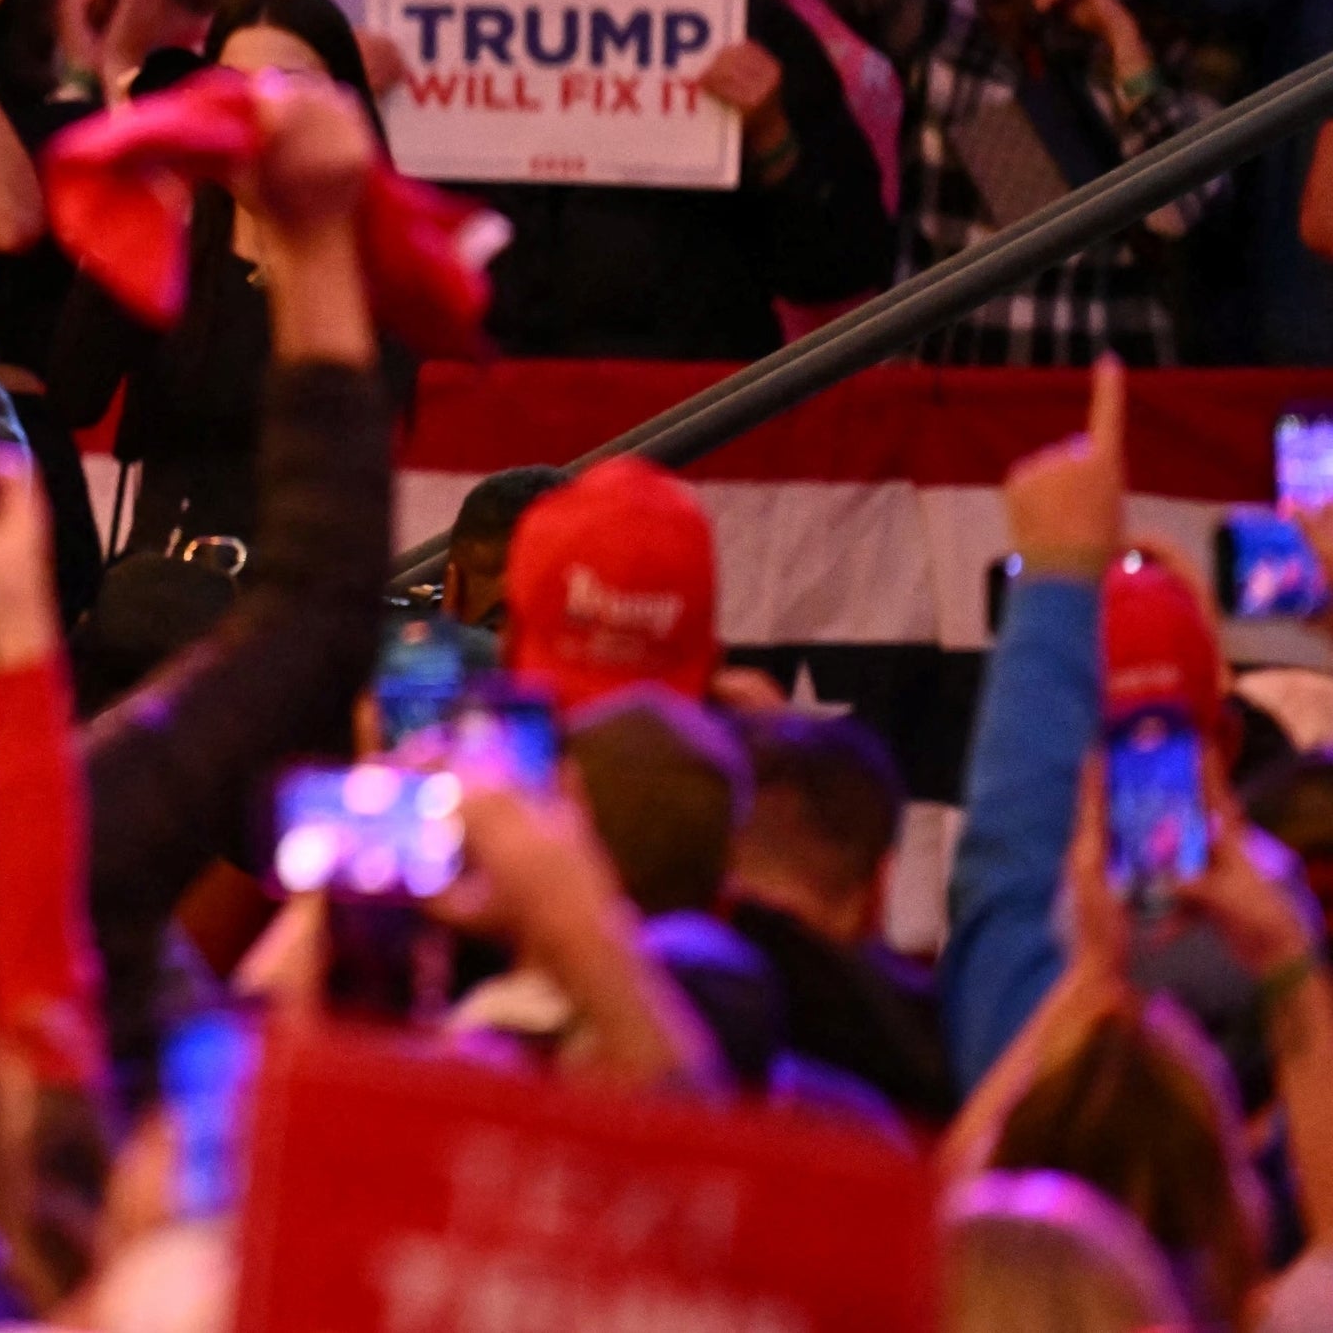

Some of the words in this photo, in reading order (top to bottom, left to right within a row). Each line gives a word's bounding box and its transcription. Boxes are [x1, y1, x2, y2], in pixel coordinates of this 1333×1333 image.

[403, 5, 711, 69] TRUMP
[405, 72, 539, 113] WILL
[559, 75, 640, 116] FIX
[660, 78, 701, 117] IT
